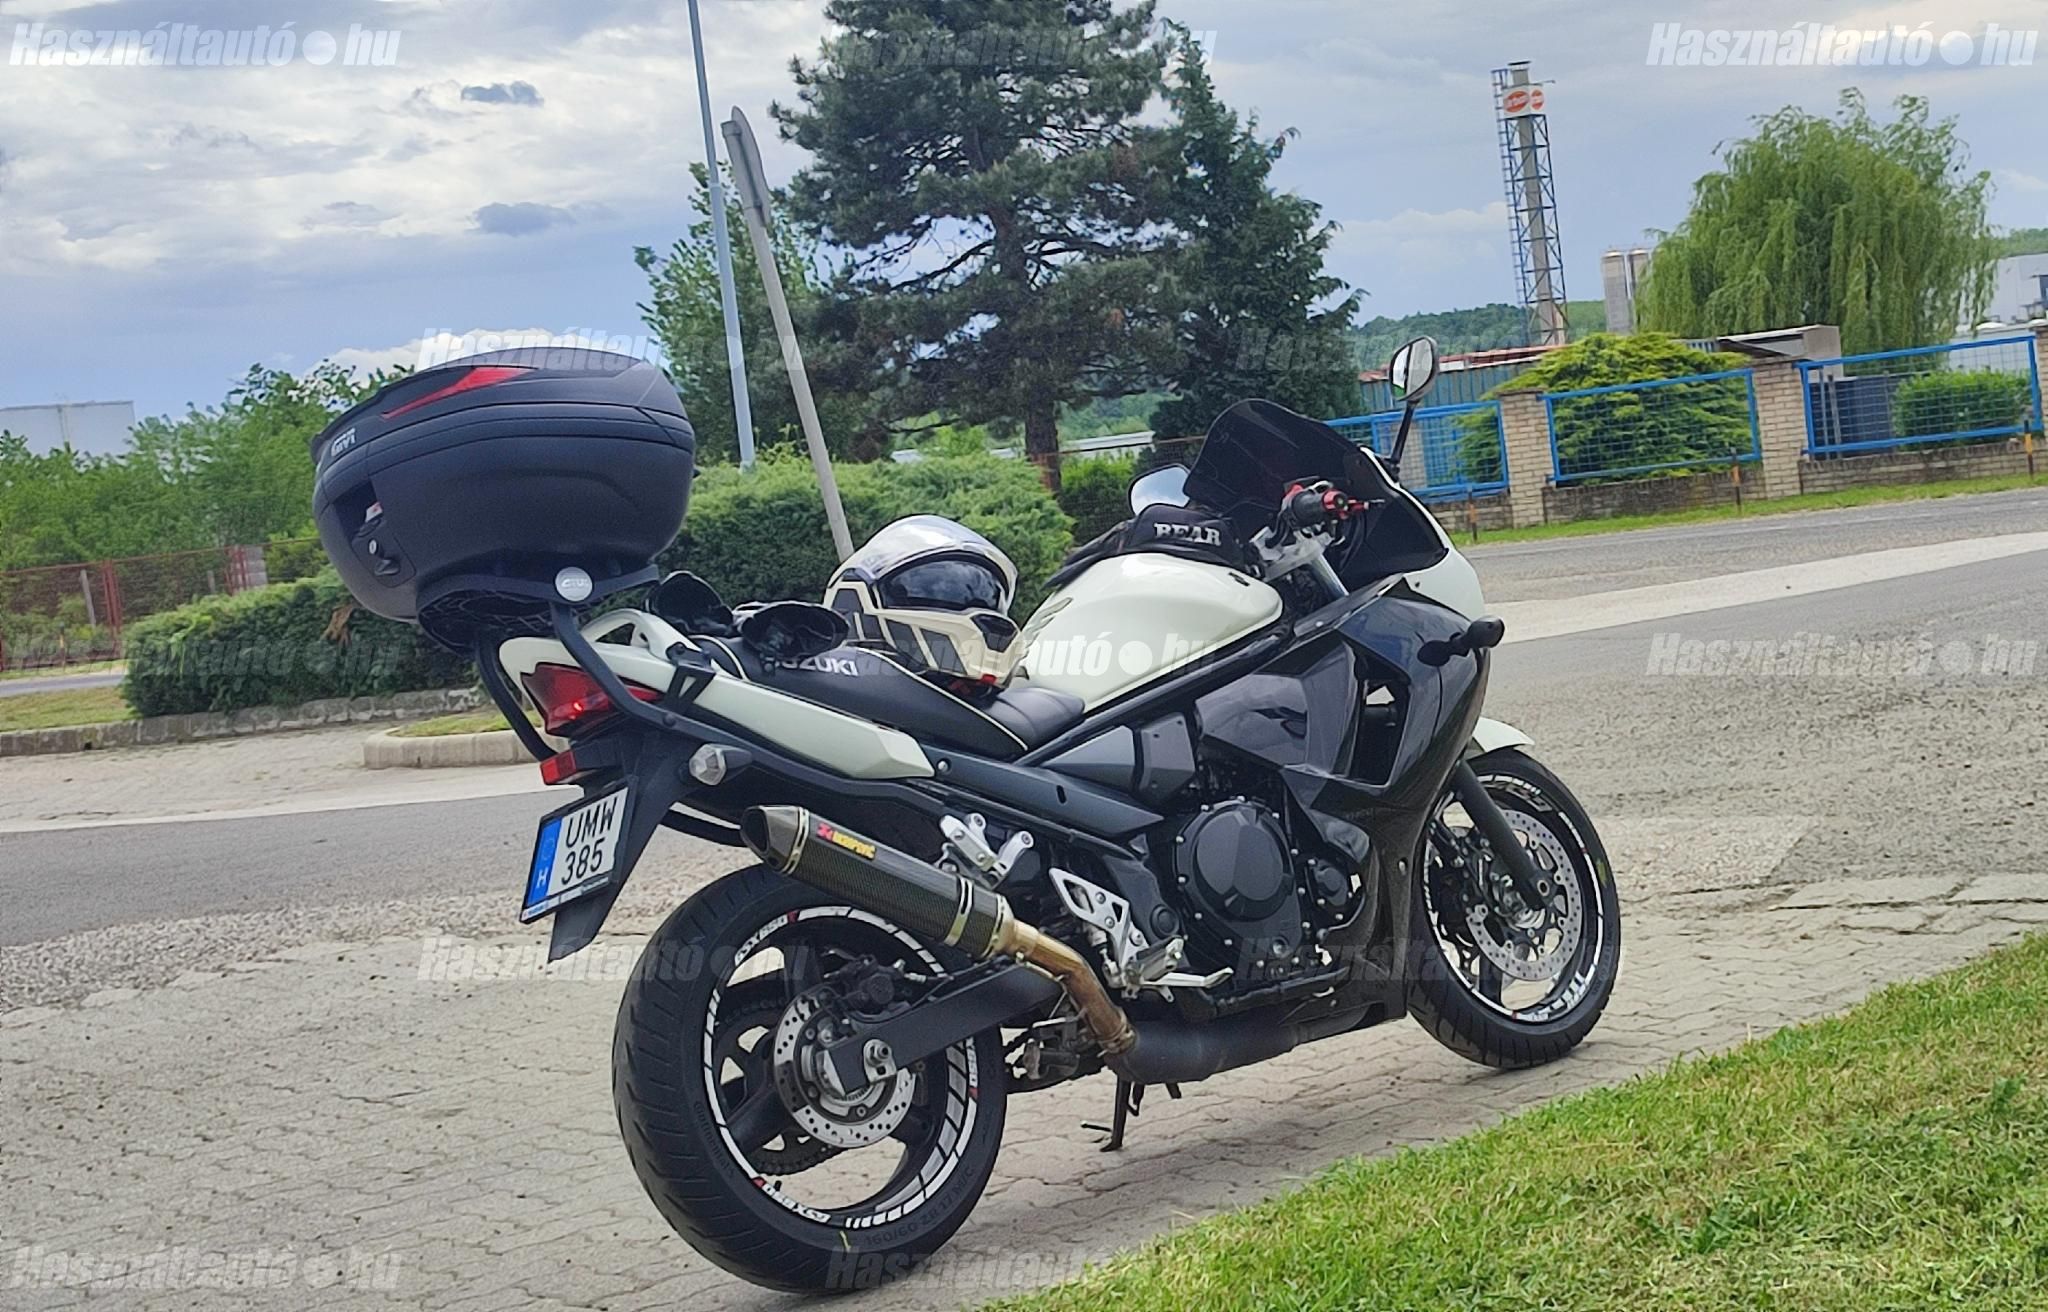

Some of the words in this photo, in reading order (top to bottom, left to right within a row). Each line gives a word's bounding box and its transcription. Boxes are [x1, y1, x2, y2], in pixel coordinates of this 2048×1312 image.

[565, 796, 618, 849] UMW
[536, 866, 548, 888] H
[561, 837, 606, 886] 385
